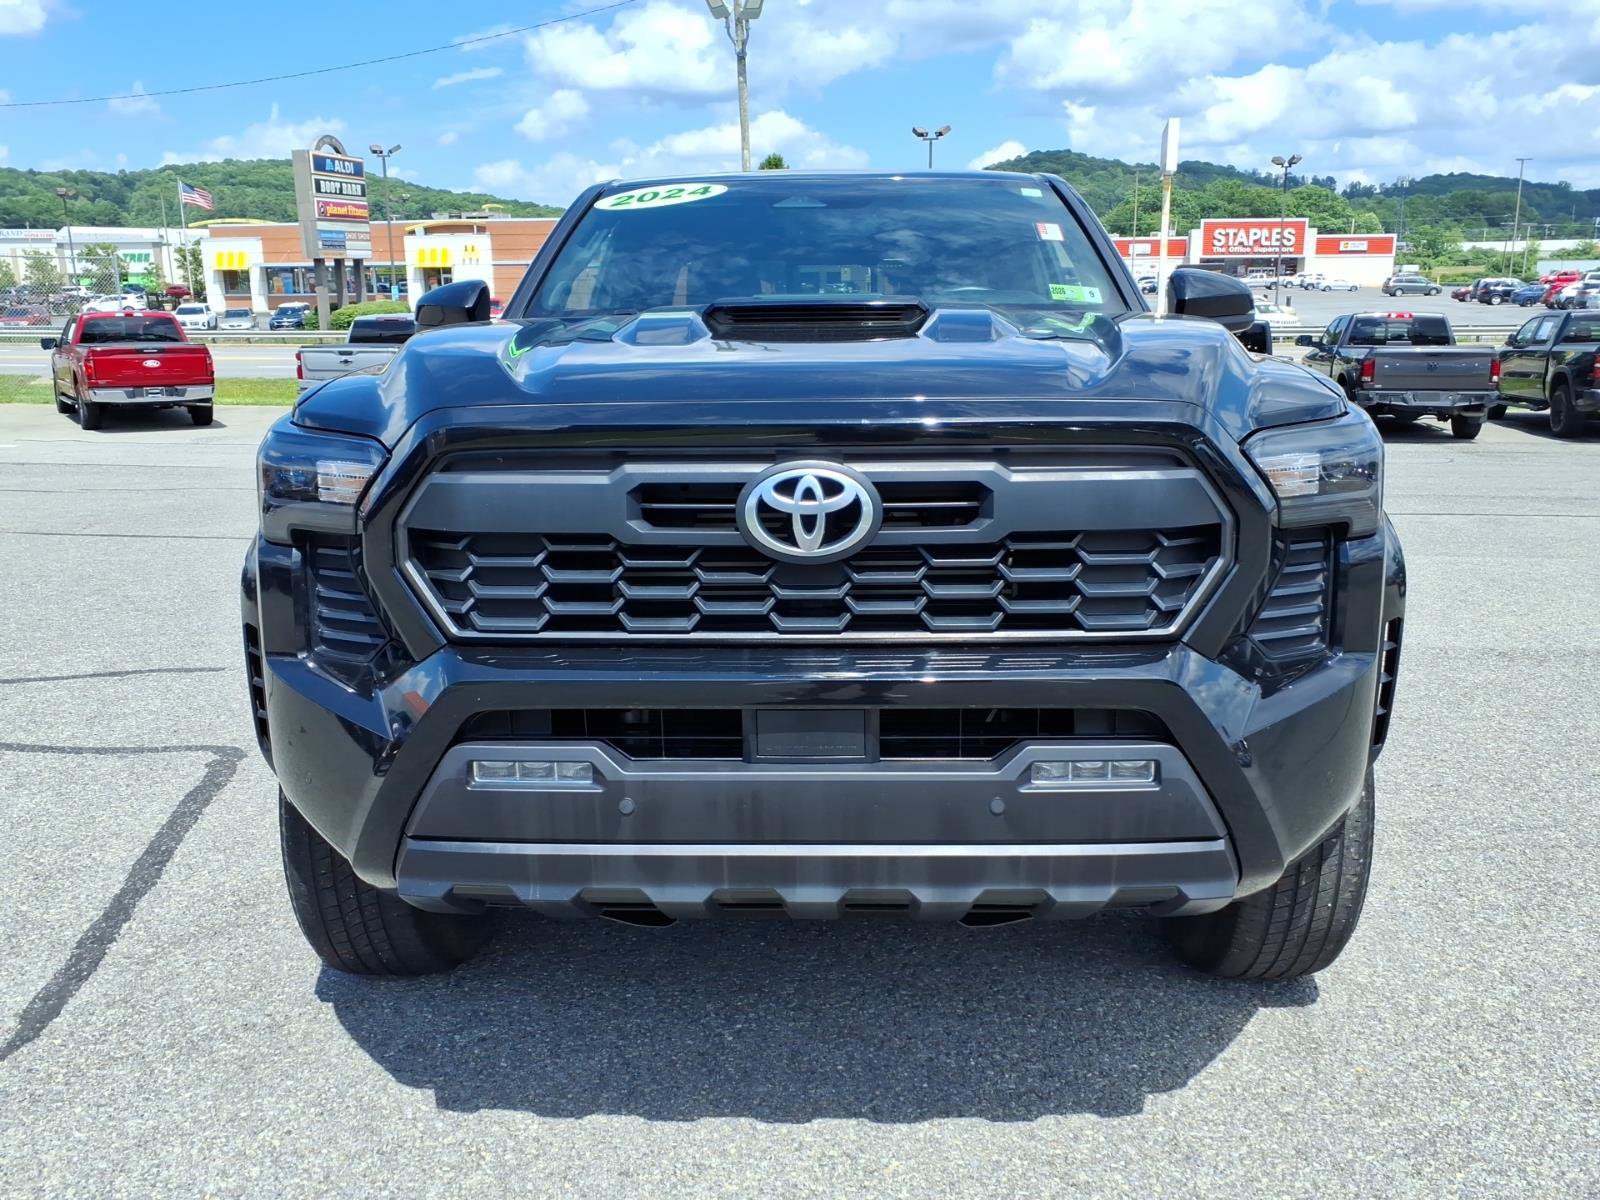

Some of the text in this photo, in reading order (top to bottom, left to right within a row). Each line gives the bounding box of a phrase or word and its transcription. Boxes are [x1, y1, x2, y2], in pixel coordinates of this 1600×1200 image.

[334, 160, 354, 175] ALDI
[320, 180, 361, 196] BOOT BARN
[609, 186, 712, 206] 2024
[1212, 227, 1296, 247] STAPLES
[122, 252, 151, 263] TREE
